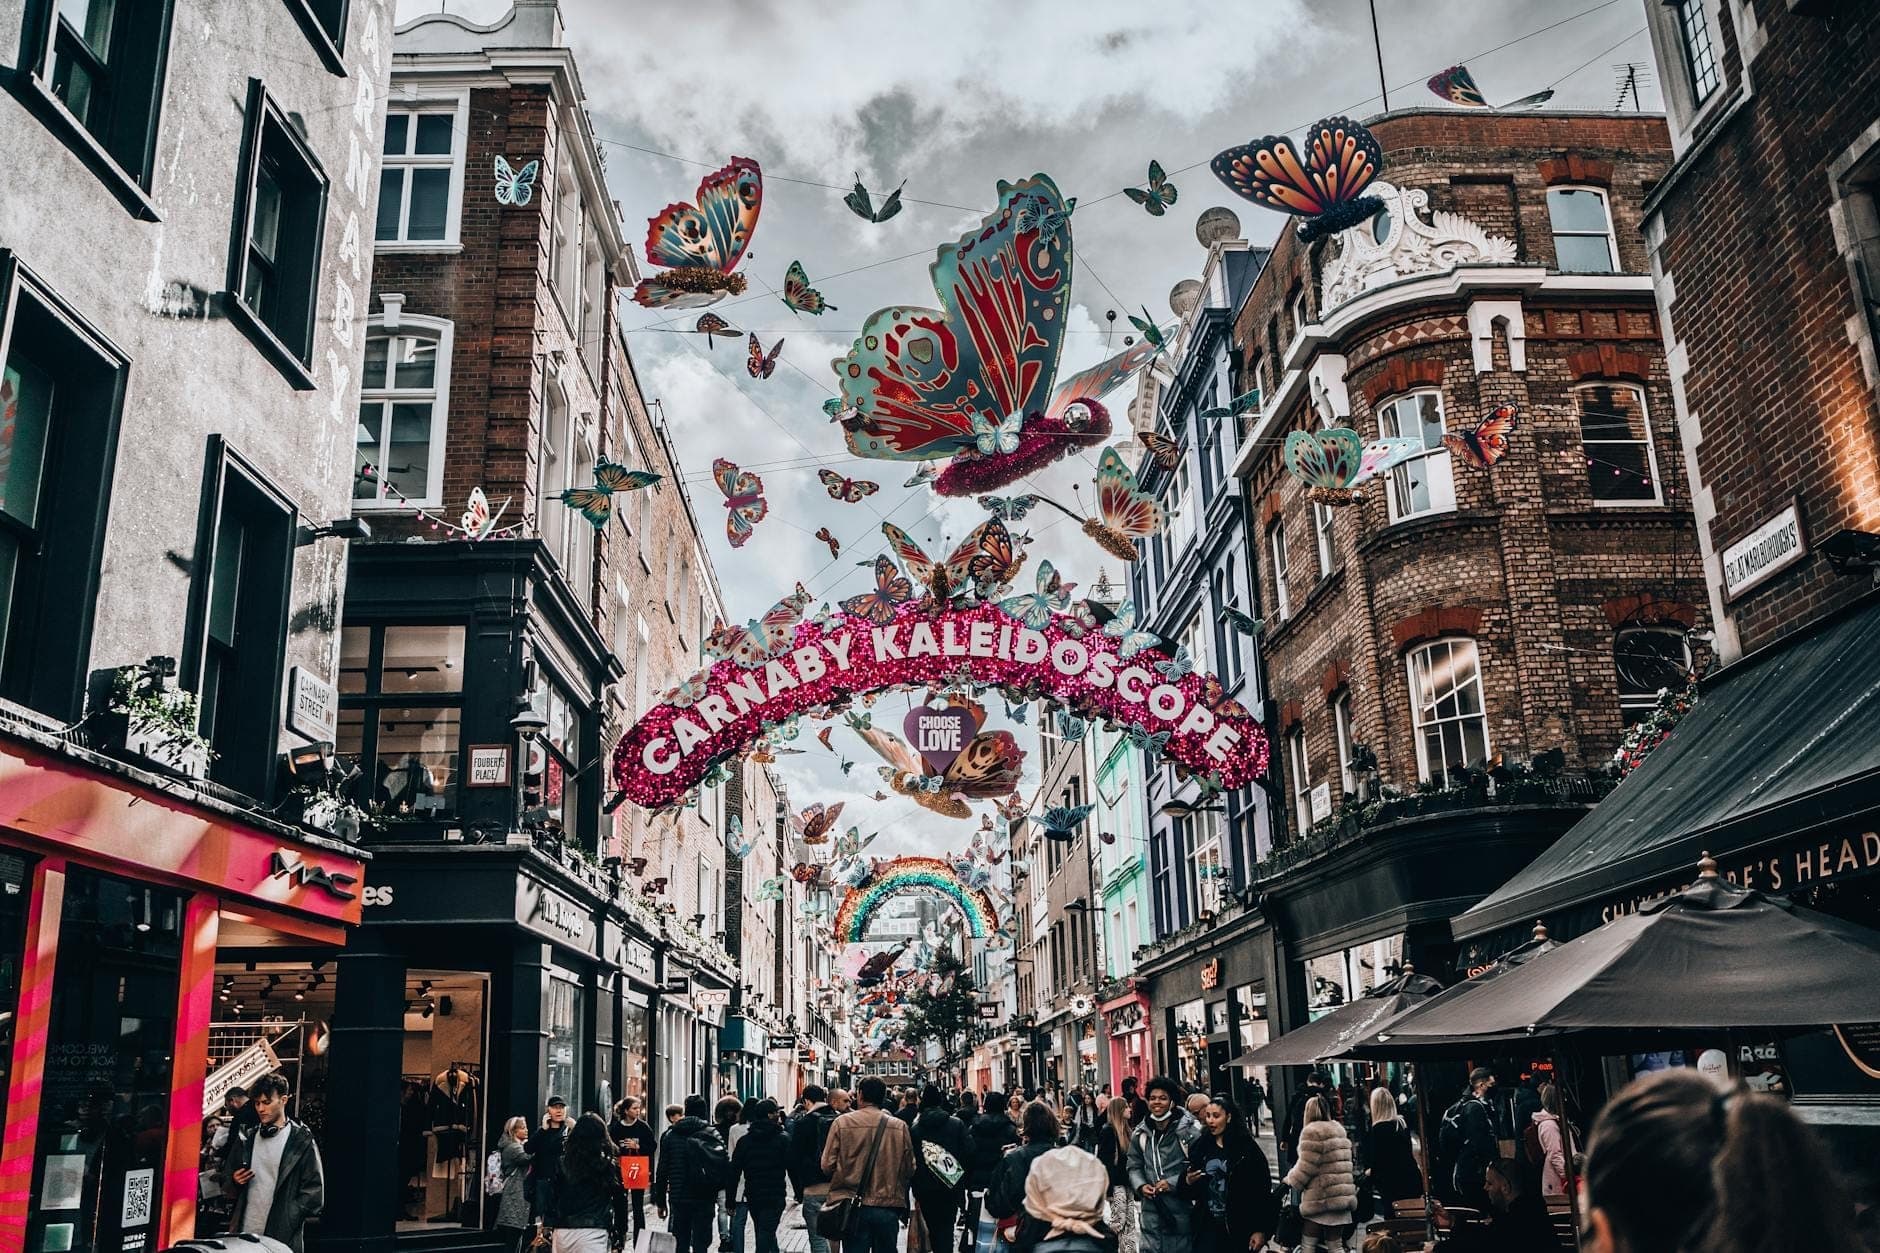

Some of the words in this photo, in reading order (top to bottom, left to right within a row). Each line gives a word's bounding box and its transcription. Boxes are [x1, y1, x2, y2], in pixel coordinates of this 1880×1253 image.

[1744, 524, 1792, 576] MARLBOROUGH
[300, 676, 330, 706] CARNABY
[642, 632, 856, 776] CARNABY
[871, 621, 1241, 762] KALEIDOSCOPE
[300, 694, 323, 721] STREET
[919, 716, 961, 730] CHOOSE
[919, 729, 961, 752] LOVE
[475, 769, 496, 780] PLACE
[1796, 832, 1880, 883] HEAD
